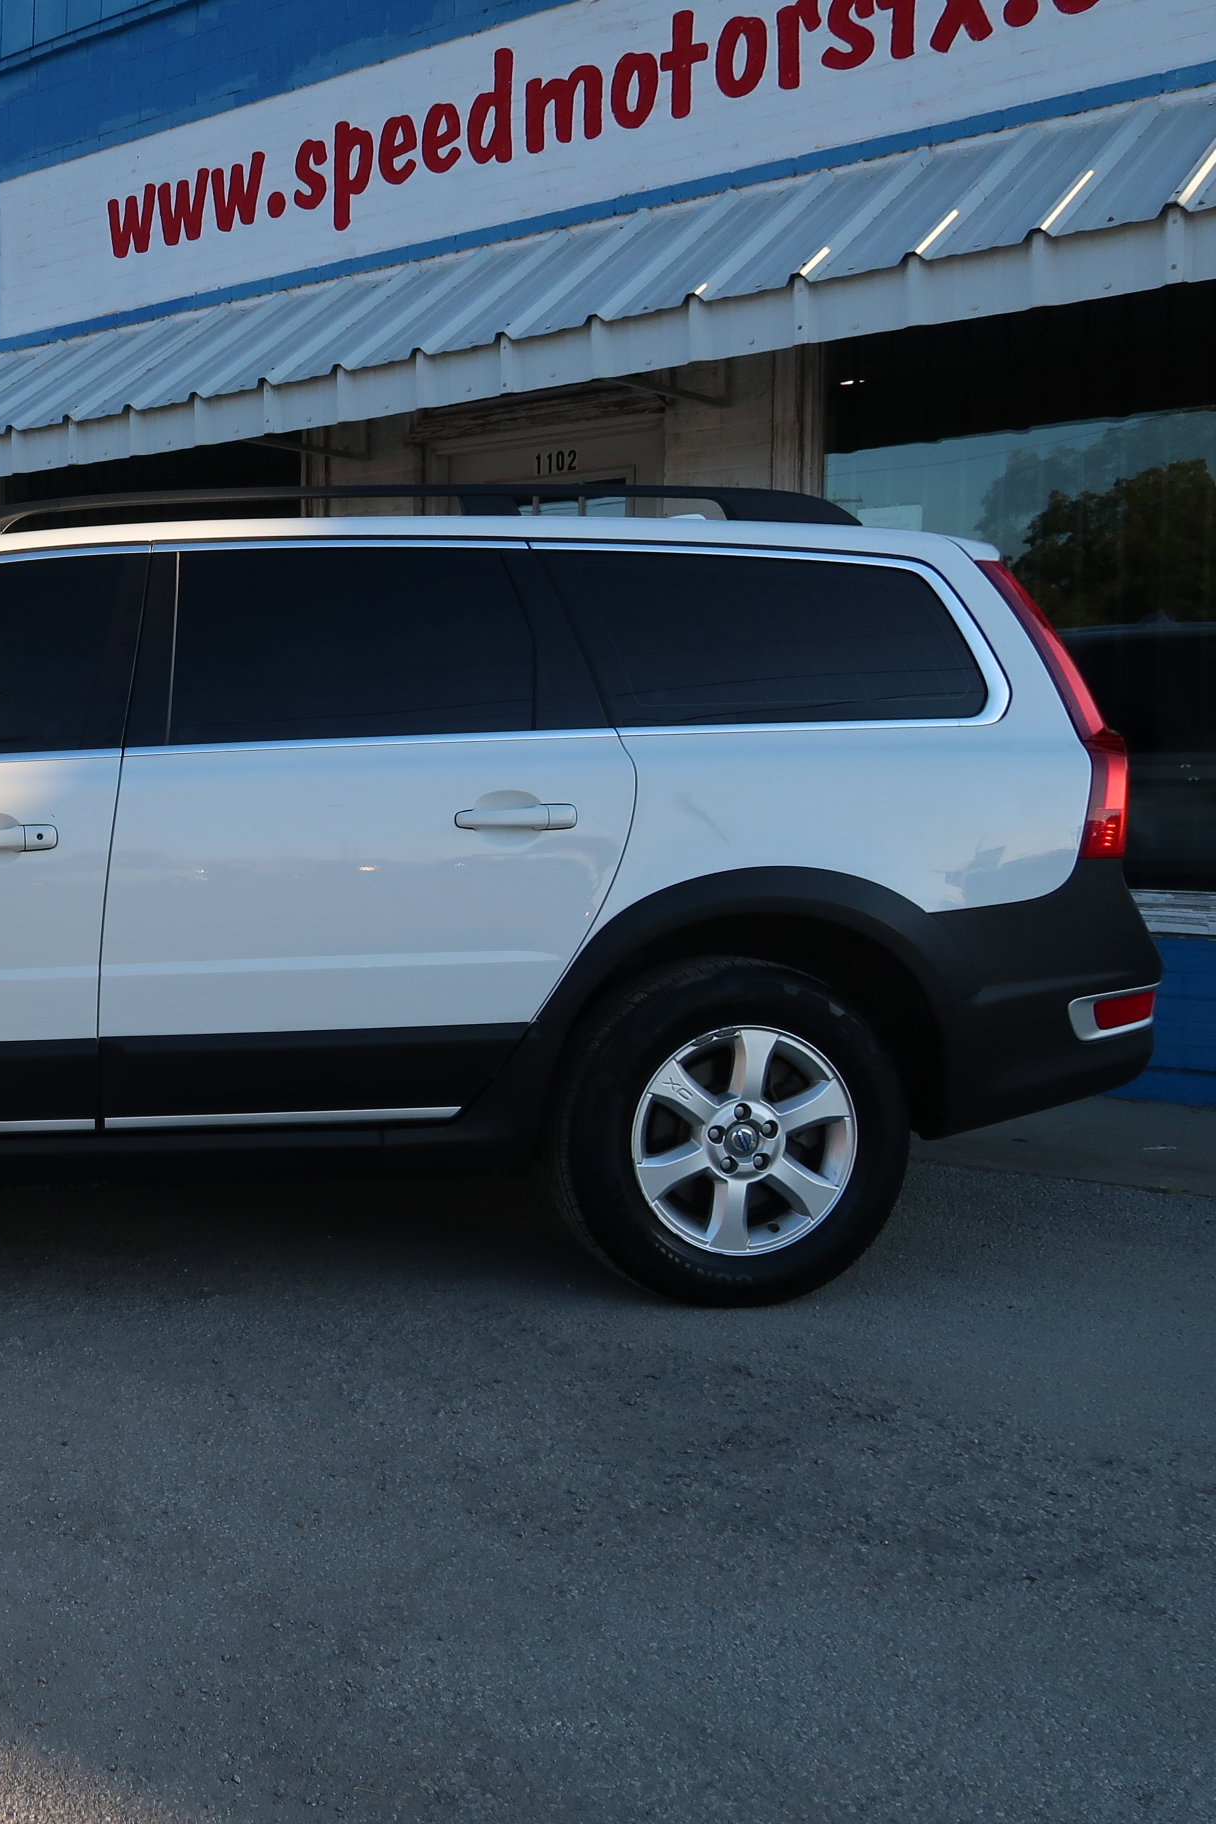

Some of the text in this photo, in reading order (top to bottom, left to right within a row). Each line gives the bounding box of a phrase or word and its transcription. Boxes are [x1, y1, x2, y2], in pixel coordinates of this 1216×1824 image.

[108, 0, 1100, 258] www.speedmotorsx.
[536, 450, 577, 475] 1102
[661, 1077, 694, 1101] XC
